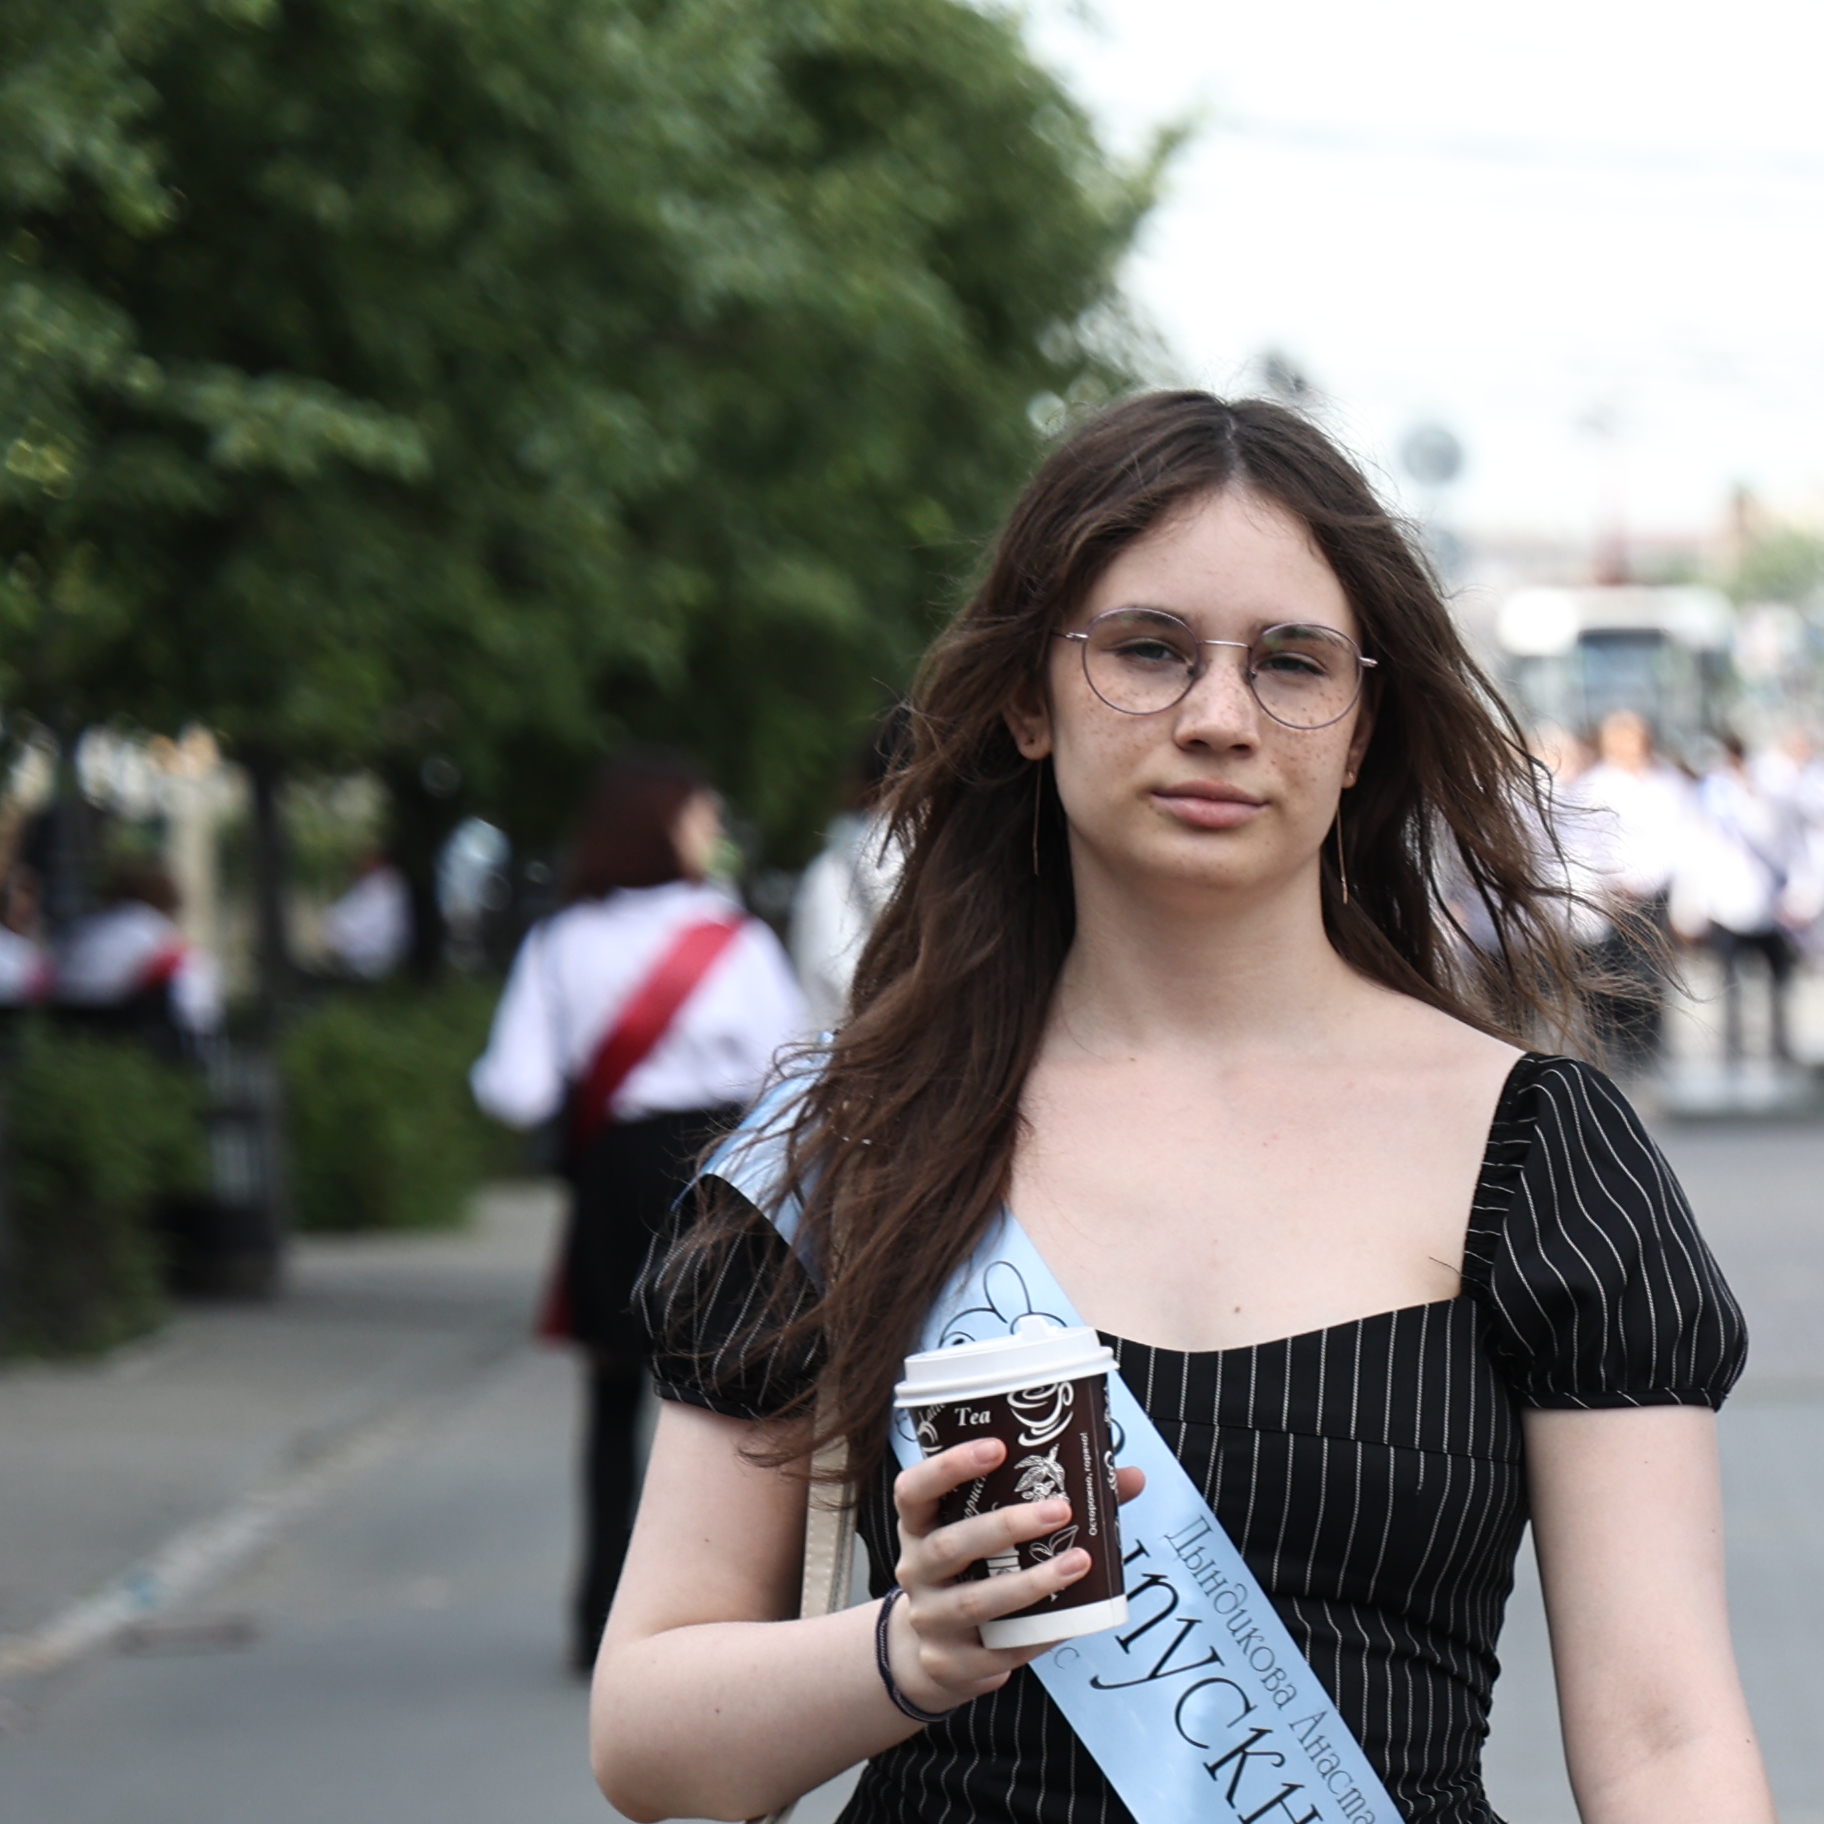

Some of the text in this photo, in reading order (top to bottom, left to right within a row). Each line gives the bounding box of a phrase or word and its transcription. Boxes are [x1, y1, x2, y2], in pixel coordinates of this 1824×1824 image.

[954, 1406, 992, 1427] Tea
[1080, 1432, 1098, 1537] Осторожно, горячо!
[1163, 1515, 1298, 1712] Дындикова
